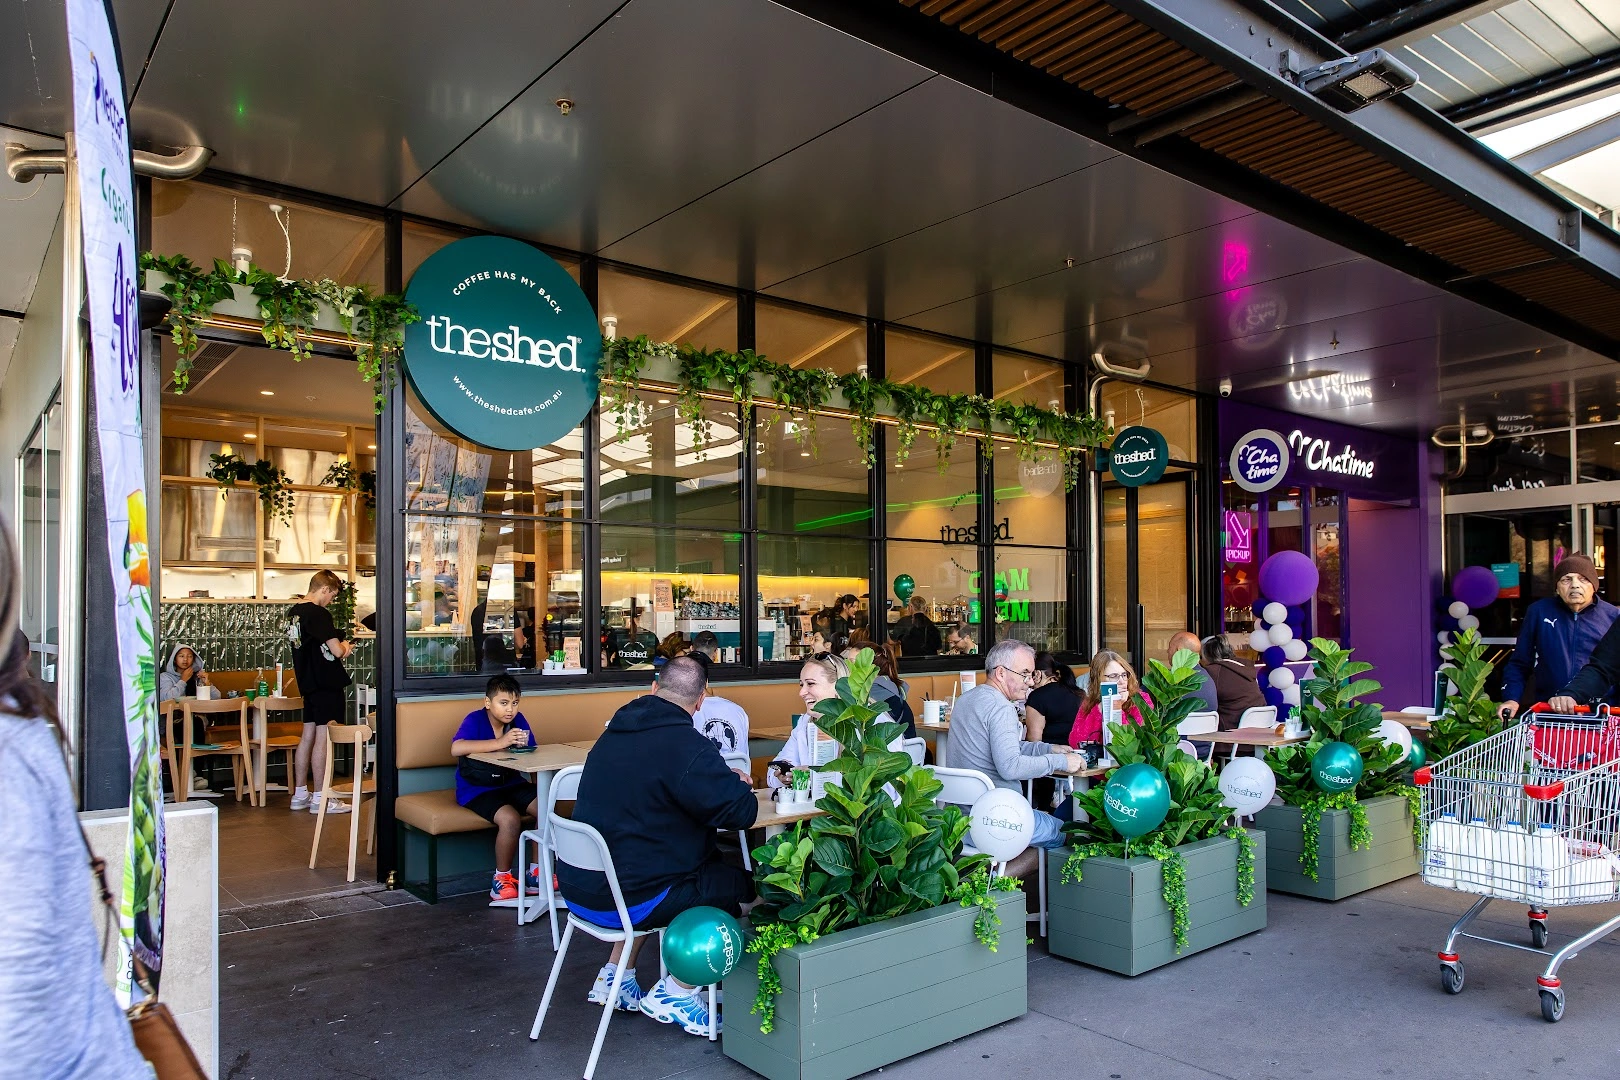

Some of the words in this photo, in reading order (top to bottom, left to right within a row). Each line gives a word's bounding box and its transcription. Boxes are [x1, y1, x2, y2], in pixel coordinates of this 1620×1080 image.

[453, 271, 491, 296] COFFEE
[494, 270, 517, 281] HAS
[520, 276, 537, 289] MY
[538, 287, 563, 315] BACK
[453, 375, 563, 416] www.theshedcafe.com.au
[1247, 448, 1279, 465] Cha
[1306, 438, 1375, 479] Chatime
[1246, 464, 1279, 480] time
[1228, 550, 1250, 560] PICKUP
